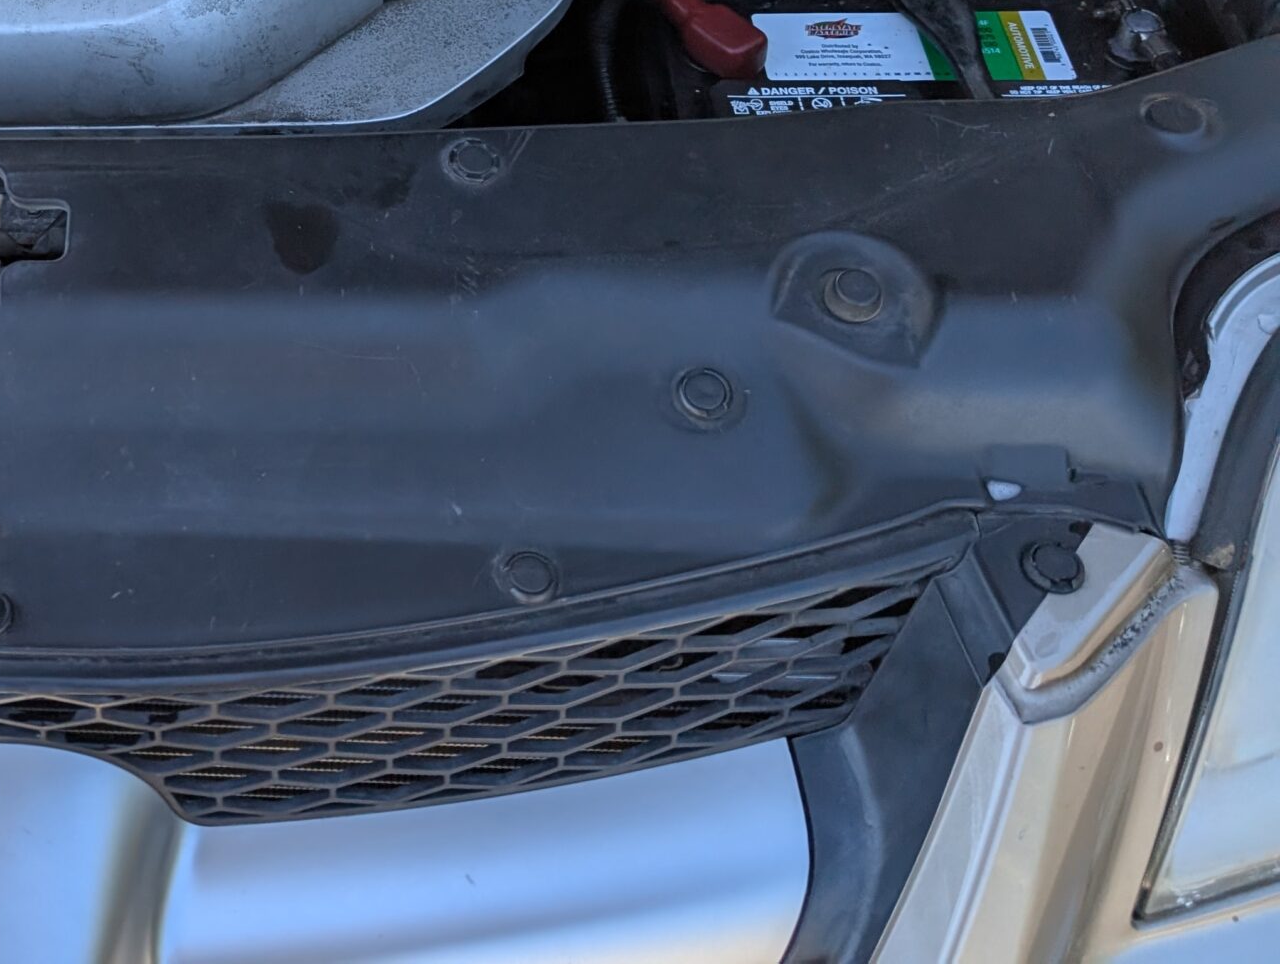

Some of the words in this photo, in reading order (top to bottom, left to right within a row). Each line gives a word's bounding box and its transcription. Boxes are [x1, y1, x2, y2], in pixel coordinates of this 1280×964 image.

[1007, 21, 1035, 69] AUTOMOTIVE
[761, 87, 815, 96] DANGER
[817, 86, 826, 95] /
[828, 86, 879, 95] POISON
